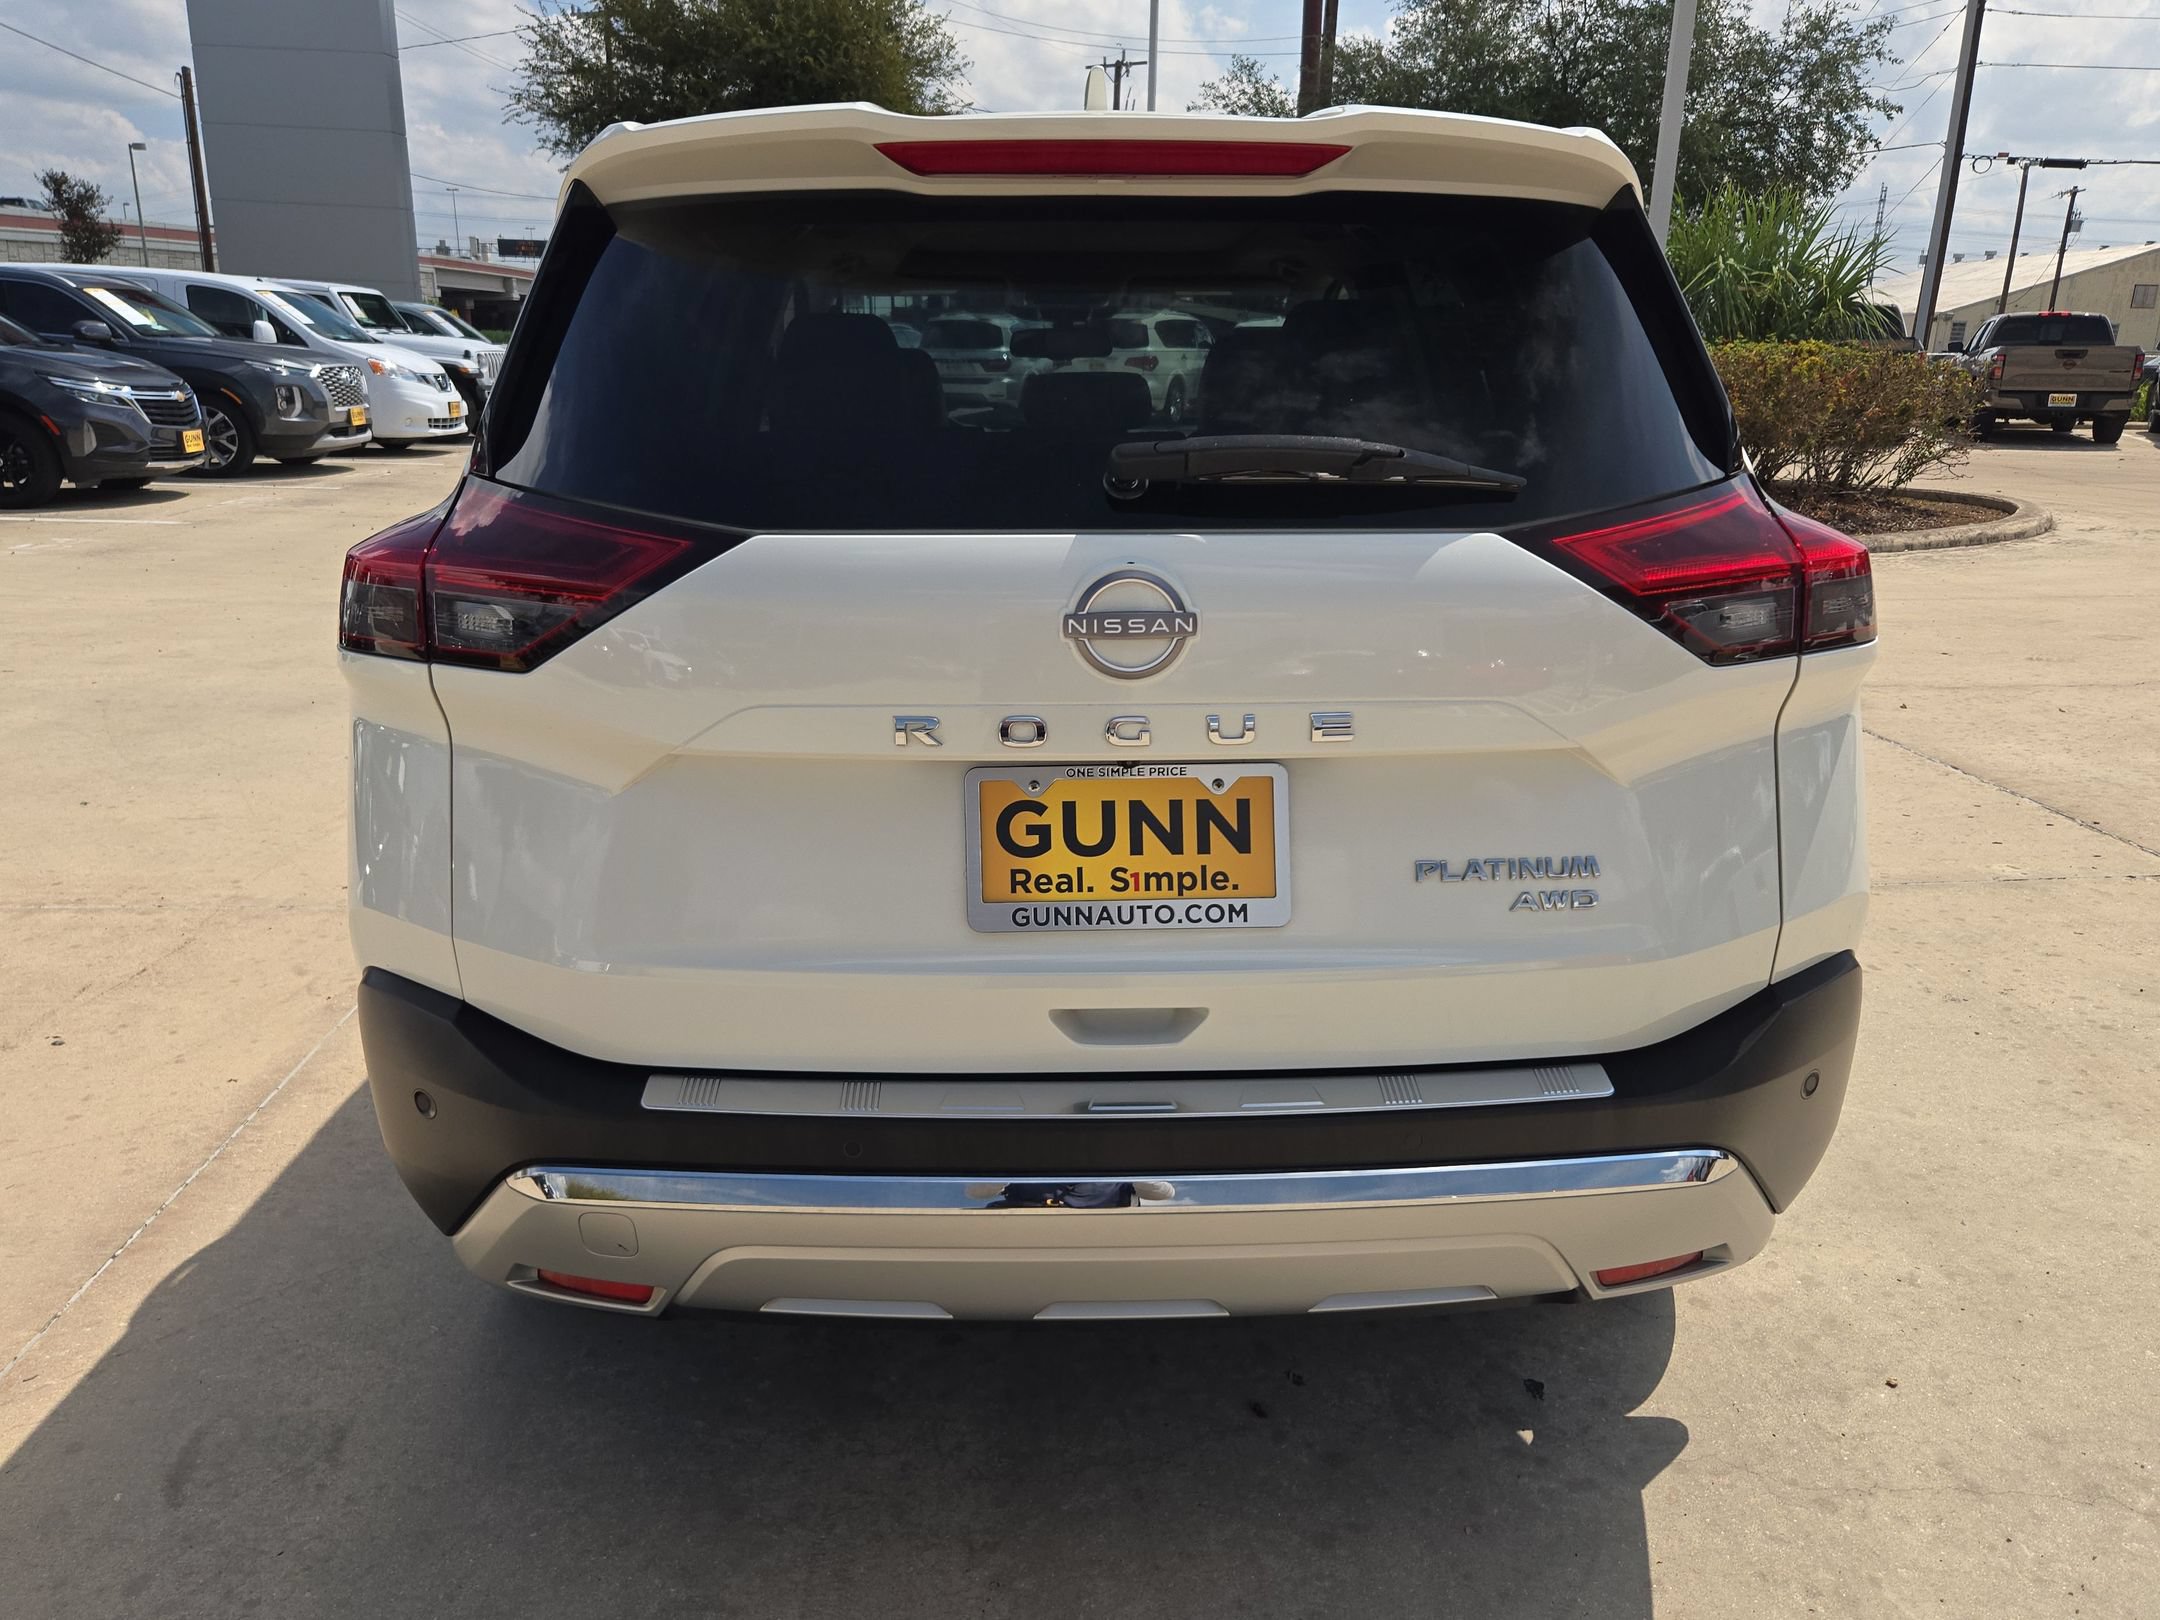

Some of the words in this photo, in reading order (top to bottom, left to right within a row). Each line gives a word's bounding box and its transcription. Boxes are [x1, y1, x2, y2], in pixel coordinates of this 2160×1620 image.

[1068, 617, 1193, 634] NISSAN
[893, 712, 1356, 747] ROGUE
[1066, 767, 1094, 777] ONE
[1098, 767, 1145, 777] SIMPLE
[1149, 766, 1188, 777] PRICE
[996, 798, 1252, 858] GUNN
[1010, 866, 1094, 893] Real.
[1415, 855, 1600, 882] PLATINUM
[1509, 889, 1599, 912] AWD
[1011, 903, 1248, 926] GUNNAUTO.COM
